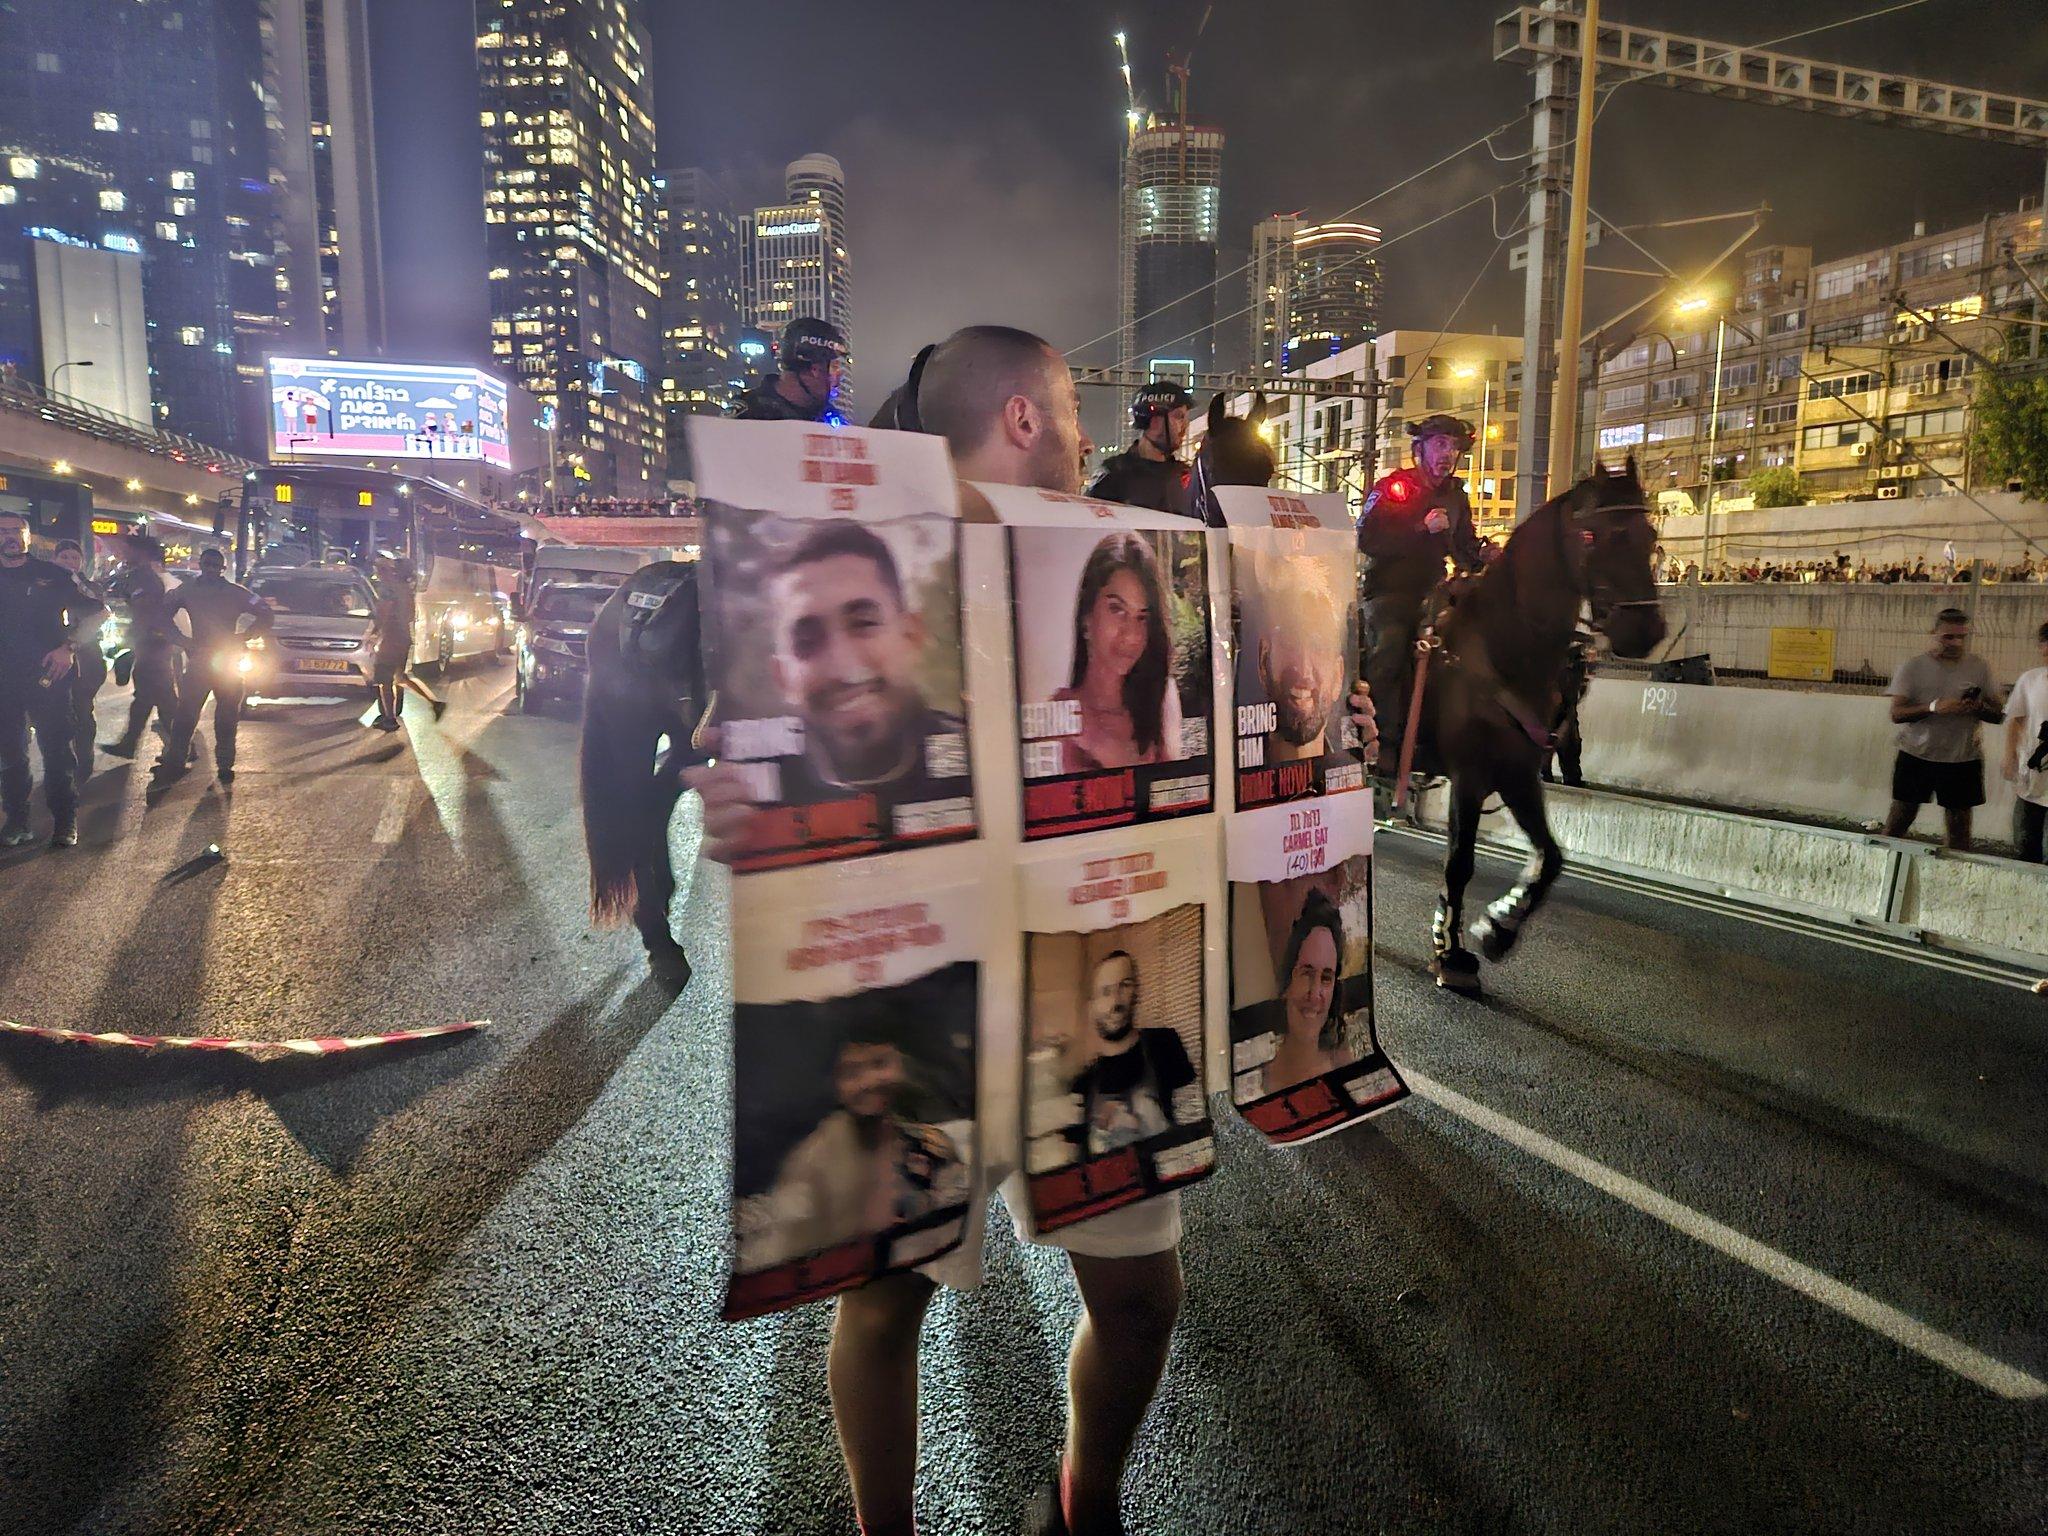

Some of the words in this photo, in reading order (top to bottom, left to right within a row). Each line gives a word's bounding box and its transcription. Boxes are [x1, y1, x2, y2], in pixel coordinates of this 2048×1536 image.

[340, 381, 410, 402] בהצלחה
[1142, 394, 1175, 402] POLICE
[341, 401, 388, 415] בשנת
[341, 413, 416, 431] הלימודים
[1641, 686, 1677, 716] 1292
[1238, 703, 1277, 735] BRING
[1238, 737, 1264, 769] HIM
[1314, 826, 1328, 845] GAT
[1287, 854, 1308, 874] (40)
